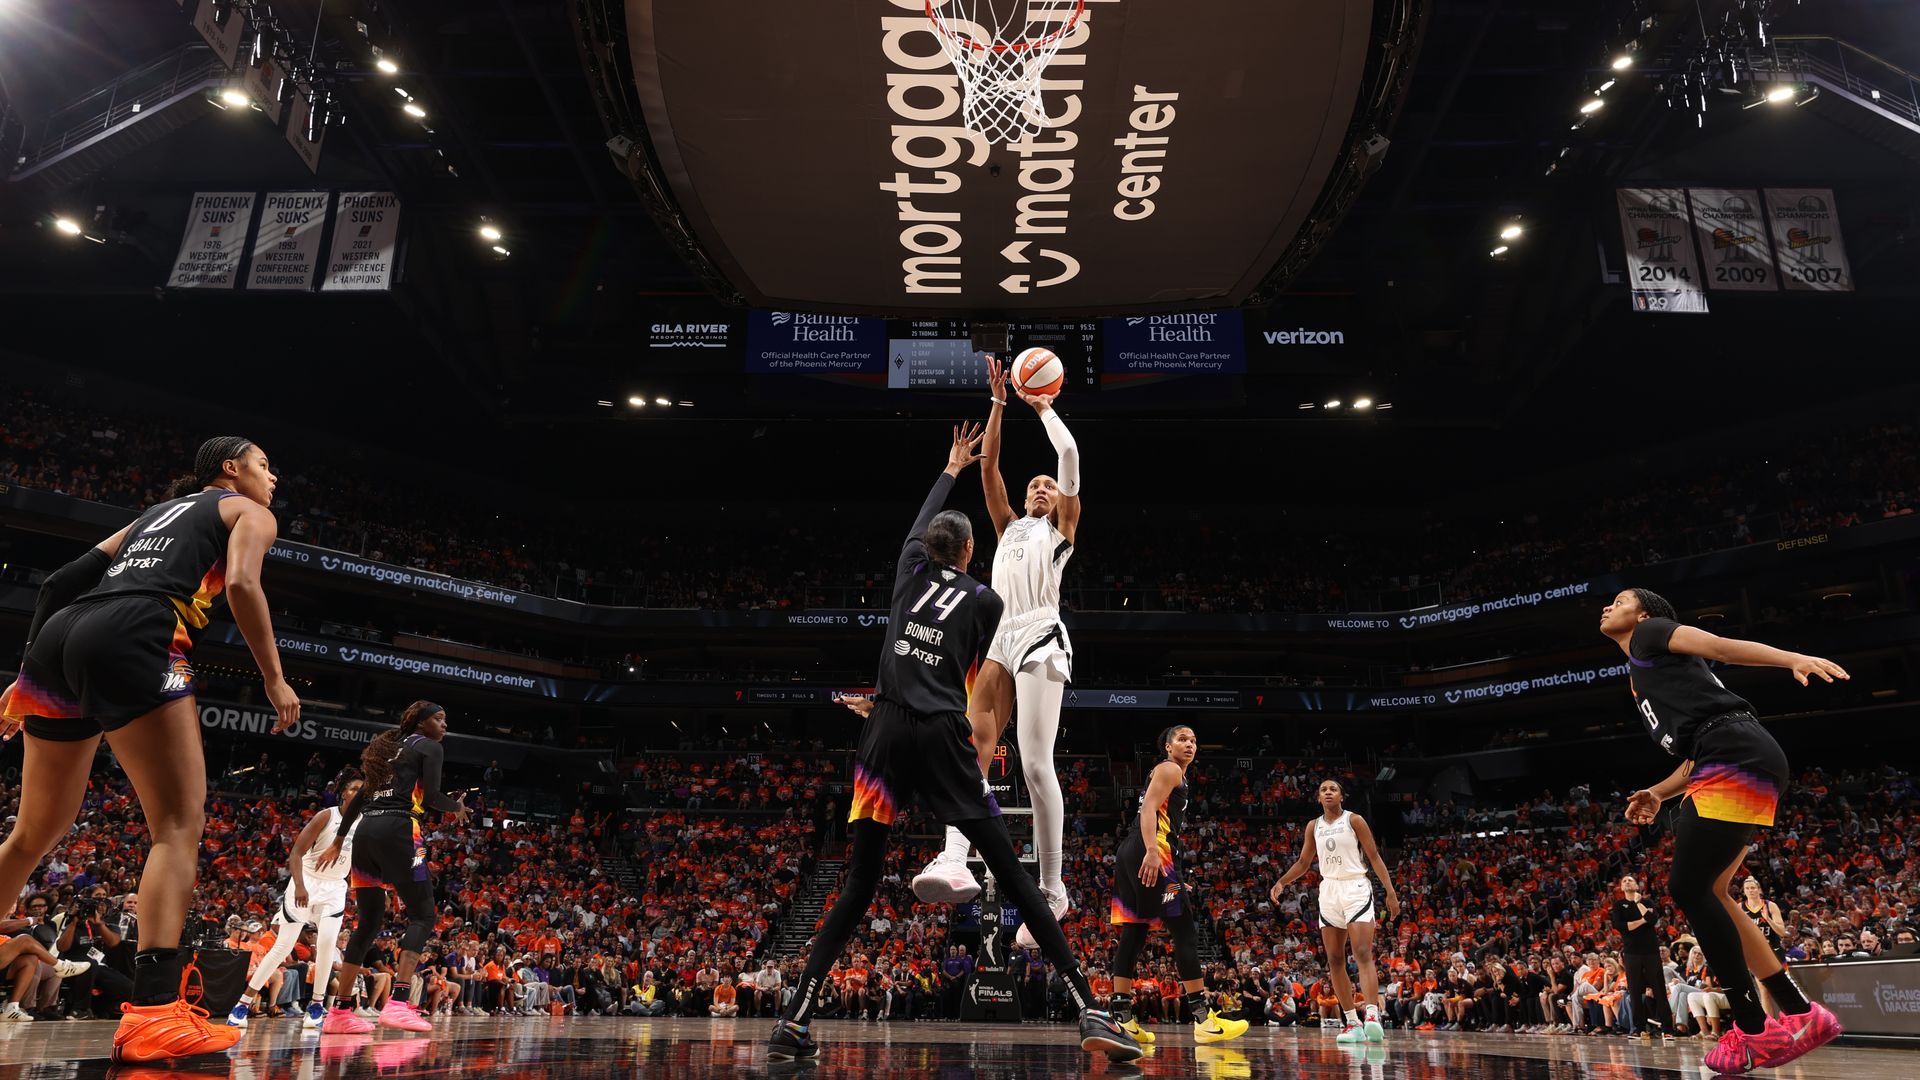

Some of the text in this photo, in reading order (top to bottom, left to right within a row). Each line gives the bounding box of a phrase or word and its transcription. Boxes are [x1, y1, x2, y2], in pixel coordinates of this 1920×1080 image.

[1006, 0, 1120, 234] matchu
[880, 0, 992, 294] mortgag
[1113, 84, 1180, 221] center
[195, 196, 250, 209] PHOENIX
[268, 196, 324, 209] PHOENIX
[344, 195, 397, 208] PHOENIX
[202, 211, 236, 223] SUNS
[276, 211, 310, 224] SUNS
[351, 211, 384, 223] SUNS
[1628, 212, 1681, 220] CHAMPIONS
[1702, 212, 1755, 220] CHAMPIONS
[1776, 212, 1830, 220] CHAMPIONS
[203, 241, 222, 249] 1976
[279, 241, 297, 250] 1993
[353, 240, 372, 249] 2021
[189, 252, 228, 260] WESTERN
[265, 252, 305, 262] WESTERN
[342, 252, 380, 260] WESTERN
[178, 263, 233, 272] CONFERENCE
[256, 264, 309, 273] CONFERENCE
[332, 263, 386, 272] CONFERENCE
[178, 274, 227, 284] CHAMPIONS
[256, 275, 305, 284] CHAMPIONS
[333, 274, 381, 284] CHAMPIONS
[1639, 266, 1691, 282] 2014
[1715, 266, 1767, 283] 2009
[1790, 267, 1842, 283] 2007
[1150, 313, 1217, 325] Banner
[651, 324, 728, 333] GILA RIVER
[792, 326, 855, 342] Health
[1149, 326, 1213, 342] Health
[1263, 327, 1345, 345] verizon
[1119, 352, 1231, 360] Official Health Care Partner
[769, 360, 862, 369] of the Phoenix Mercury
[1128, 360, 1223, 370] of the Phoenix Mercury
[143, 501, 196, 533] 0
[123, 536, 174, 558] SBALLY
[1777, 533, 1828, 551] DEFENSE!
[125, 557, 163, 571] AT&T
[295, 551, 517, 604] TO mortgage matchup center
[910, 580, 968, 621] 14
[1328, 582, 1590, 628] WELCOME TO mortgage matchup center
[788, 616, 848, 624] WELCOME TO
[904, 621, 944, 646] BONNER
[911, 647, 944, 667] AT&T
[314, 644, 536, 688] TO mortgage matchup center
[1371, 696, 1421, 707] WELCOME
[1422, 695, 1436, 704] TO
[1464, 679, 1530, 700] mortgage
[1531, 668, 1595, 689] matchup
[1108, 693, 1137, 705] Aces
[1325, 838, 1336, 852] 0
[1325, 855, 1342, 866] ring
[983, 912, 999, 922] ally
